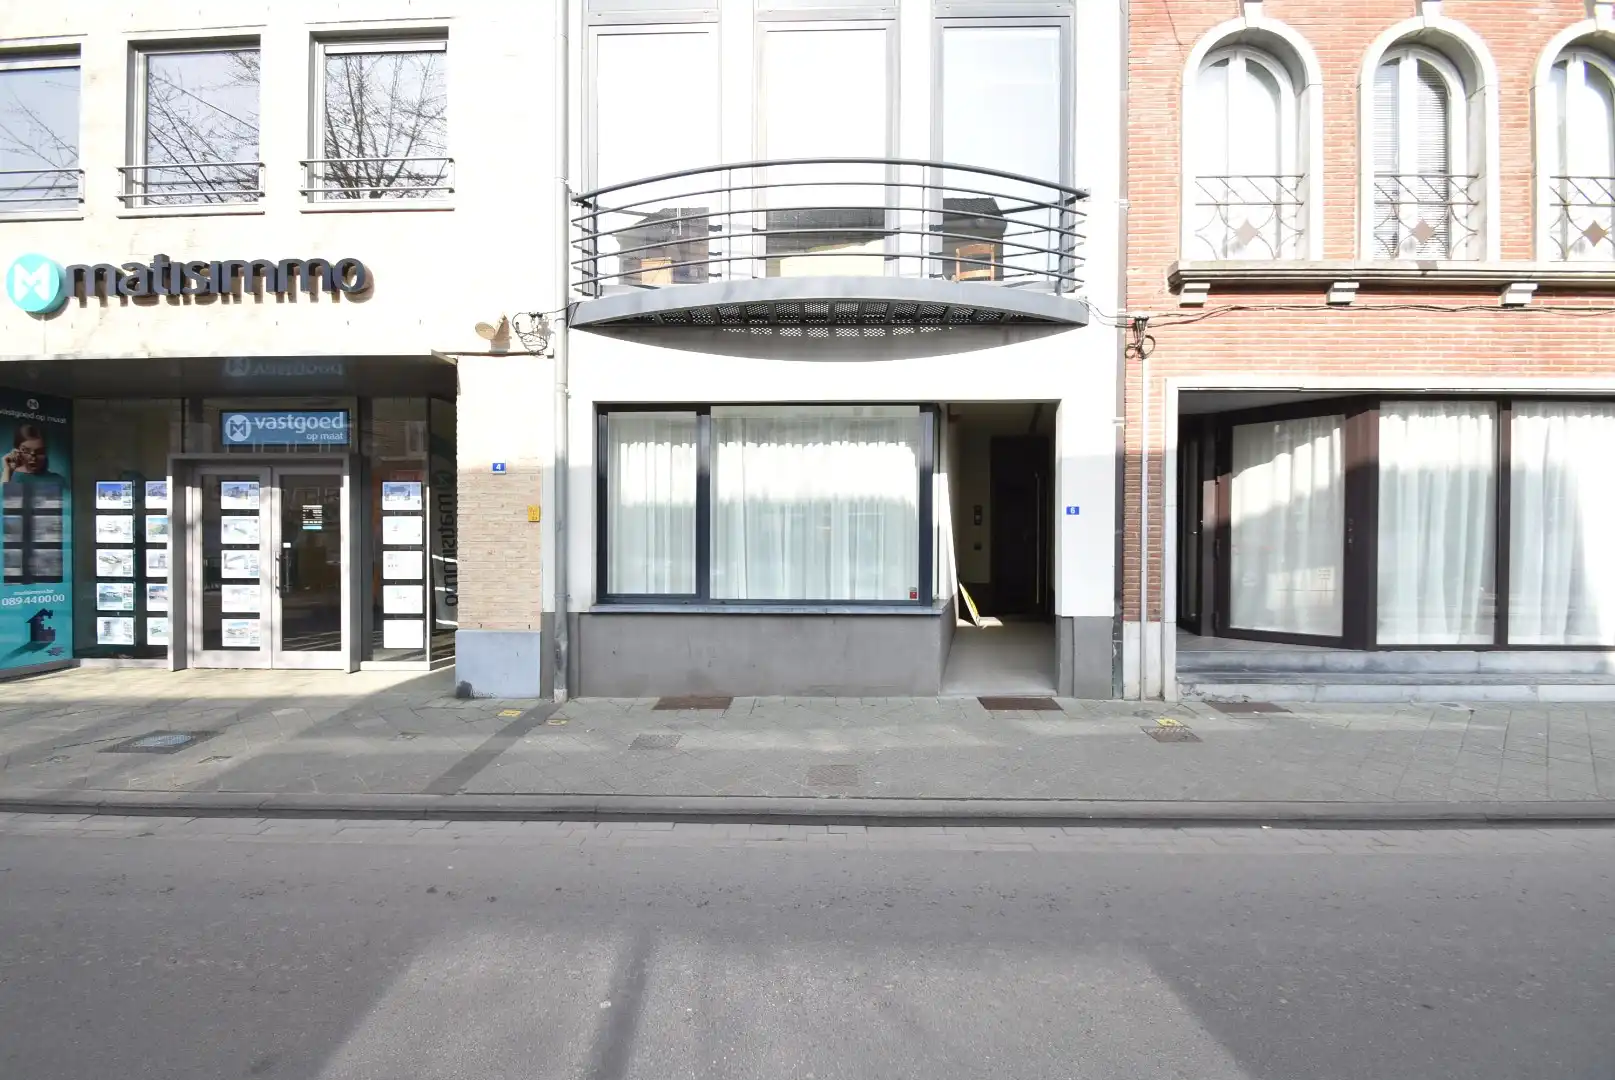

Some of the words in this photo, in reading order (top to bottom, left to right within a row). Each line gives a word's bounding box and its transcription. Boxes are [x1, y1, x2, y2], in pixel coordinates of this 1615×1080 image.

[65, 254, 366, 298] matisimmo
[254, 412, 344, 434] vastgoed
[306, 432, 318, 441] op
[320, 431, 344, 440] maat
